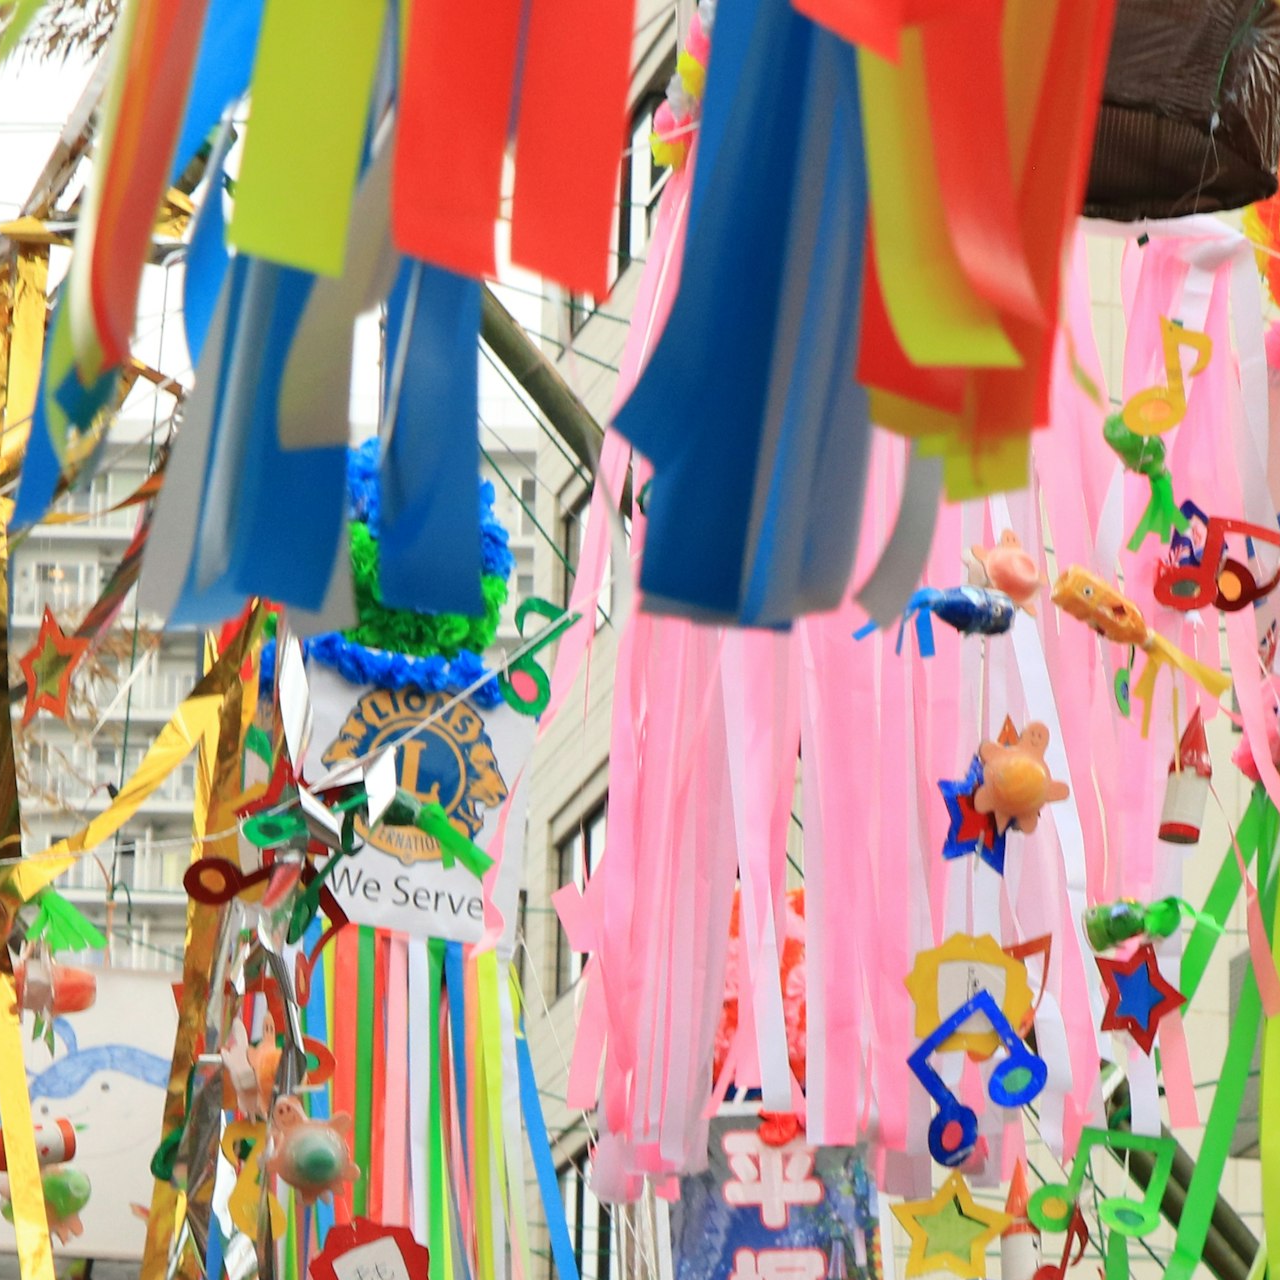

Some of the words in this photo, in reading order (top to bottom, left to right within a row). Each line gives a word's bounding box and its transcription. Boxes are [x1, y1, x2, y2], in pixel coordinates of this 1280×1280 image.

[374, 692, 476, 738] LIONS
[400, 740, 441, 806] L
[331, 864, 382, 903] We
[391, 873, 485, 923] Serve
